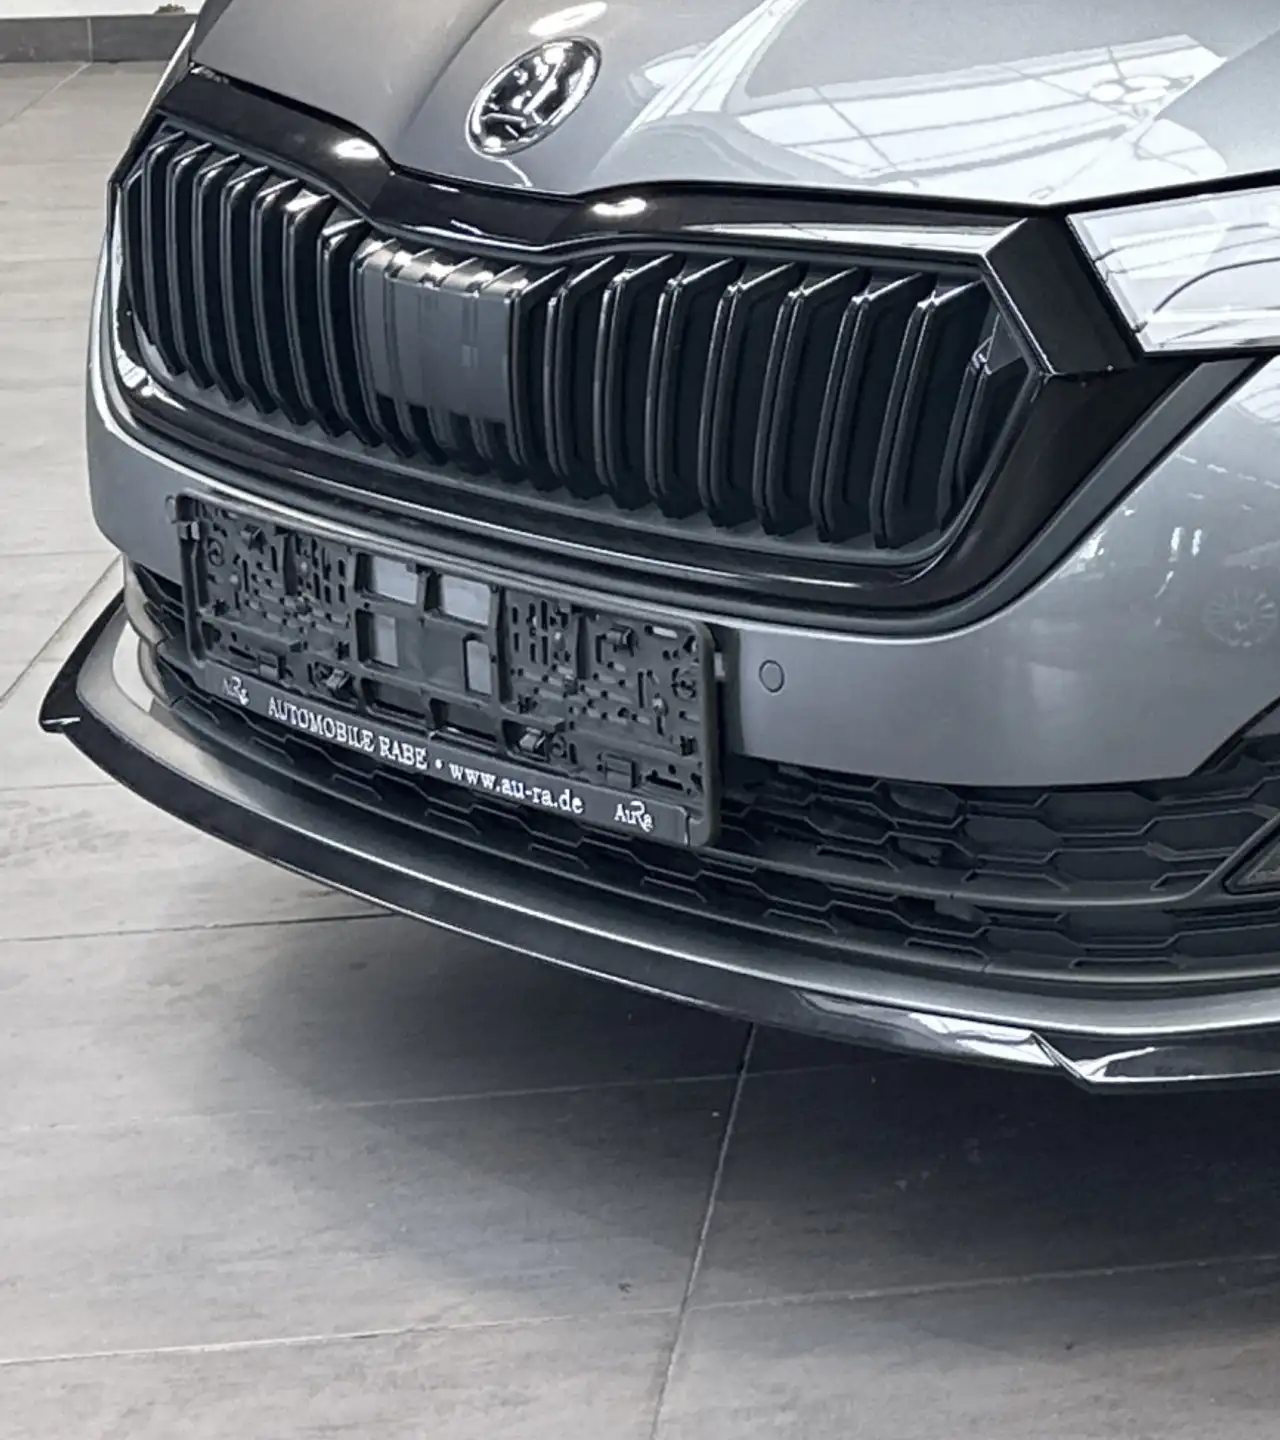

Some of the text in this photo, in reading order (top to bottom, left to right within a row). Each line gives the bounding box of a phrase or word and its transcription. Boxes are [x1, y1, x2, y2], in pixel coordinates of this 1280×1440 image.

[268, 696, 375, 753] AUTOMOBILE
[378, 735, 428, 770] RABE
[448, 763, 584, 814] www.au-ra.de
